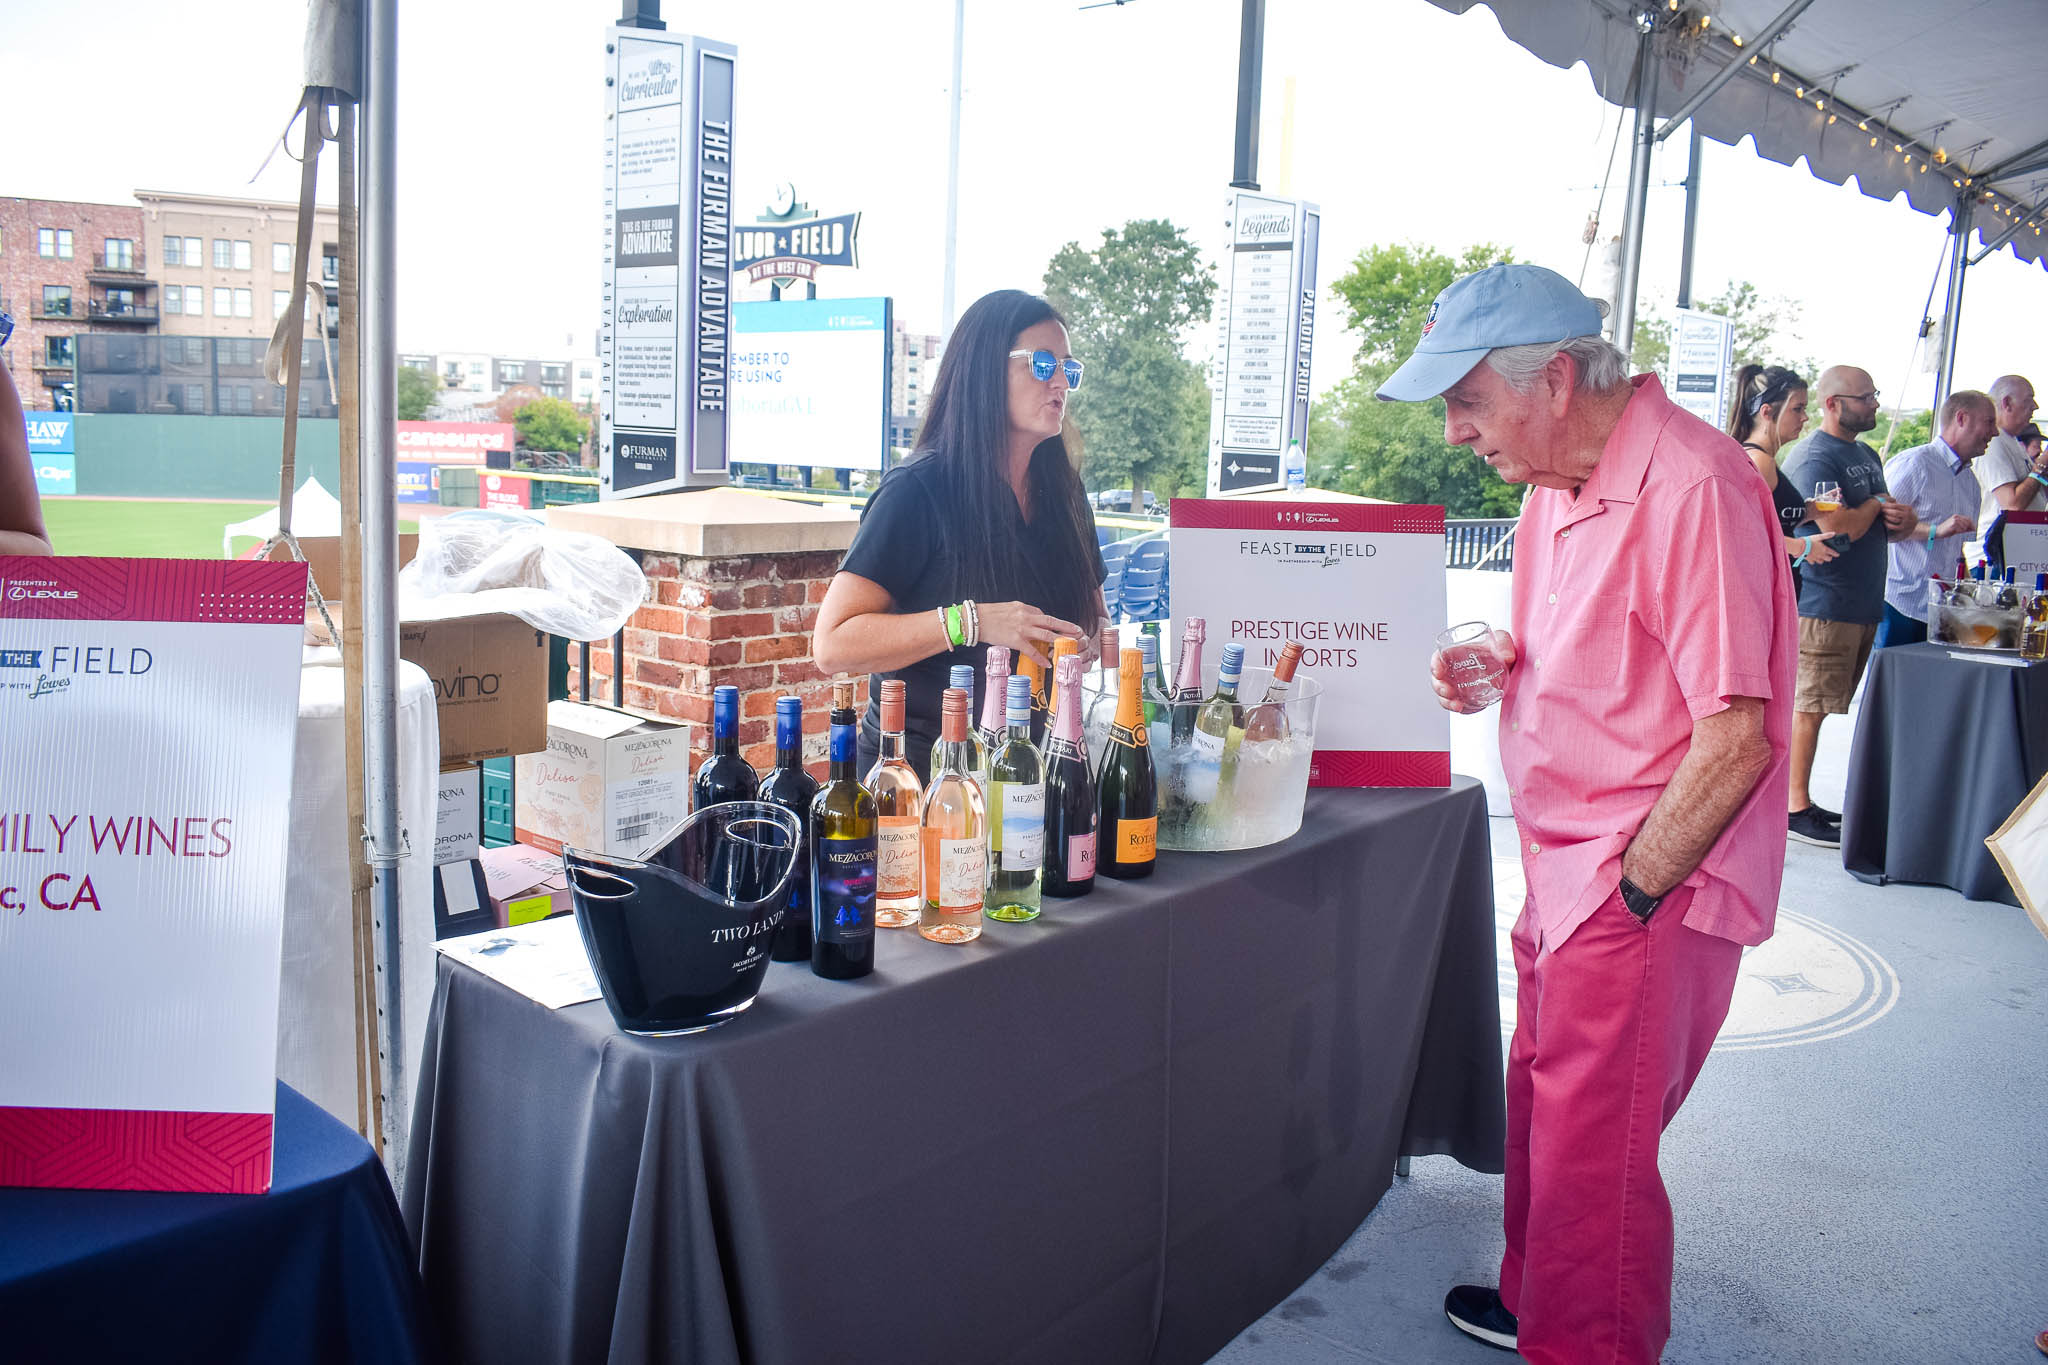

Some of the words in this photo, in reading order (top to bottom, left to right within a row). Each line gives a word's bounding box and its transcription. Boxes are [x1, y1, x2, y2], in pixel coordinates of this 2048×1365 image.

[621, 74, 678, 102] Curricular
[703, 120, 729, 163] THE
[702, 169, 728, 268] FURMAN
[1241, 216, 1290, 241] Legends
[621, 231, 673, 255] ADVANTAGE
[791, 223, 844, 255] FIELD
[618, 304, 673, 329] Exploration
[602, 282, 612, 397] ADVANTAGE
[699, 275, 726, 411] ADVANTAGE
[774, 352, 790, 366] TO
[746, 370, 782, 383] USING
[630, 446, 667, 457] FURMAN
[1240, 542, 1292, 555] FEAST
[1330, 543, 1377, 557] FIELD
[2020, 563, 2038, 572] CITY
[27, 590, 79, 599] LEXUS
[1231, 620, 1329, 640] PRESTIGE
[1334, 622, 1388, 641] WINE
[5, 653, 32, 664] THE
[52, 646, 153, 675] FIELD
[1264, 648, 1357, 668] IORTS
[89, 815, 233, 858] WINES
[40, 873, 102, 911] CA
[711, 925, 750, 943] TWO
